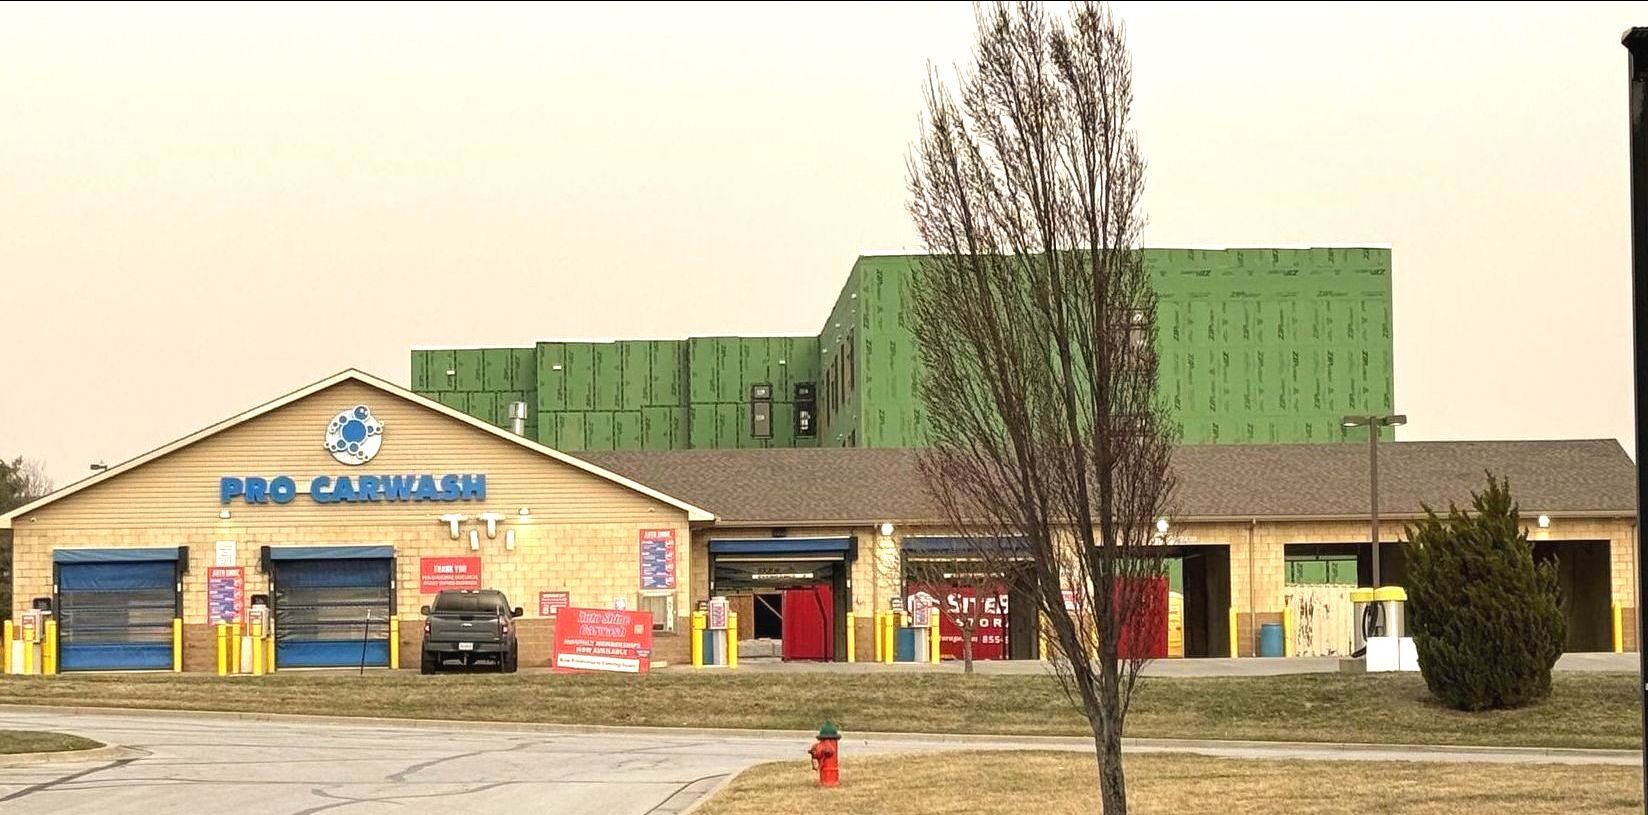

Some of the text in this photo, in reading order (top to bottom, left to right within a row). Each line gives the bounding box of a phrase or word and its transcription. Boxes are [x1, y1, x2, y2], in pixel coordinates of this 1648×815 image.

[220, 474, 487, 504] PRO CARWASH
[455, 565, 467, 573] YOU
[575, 646, 593, 654] NOW
[592, 647, 628, 656] AVAILABLE
